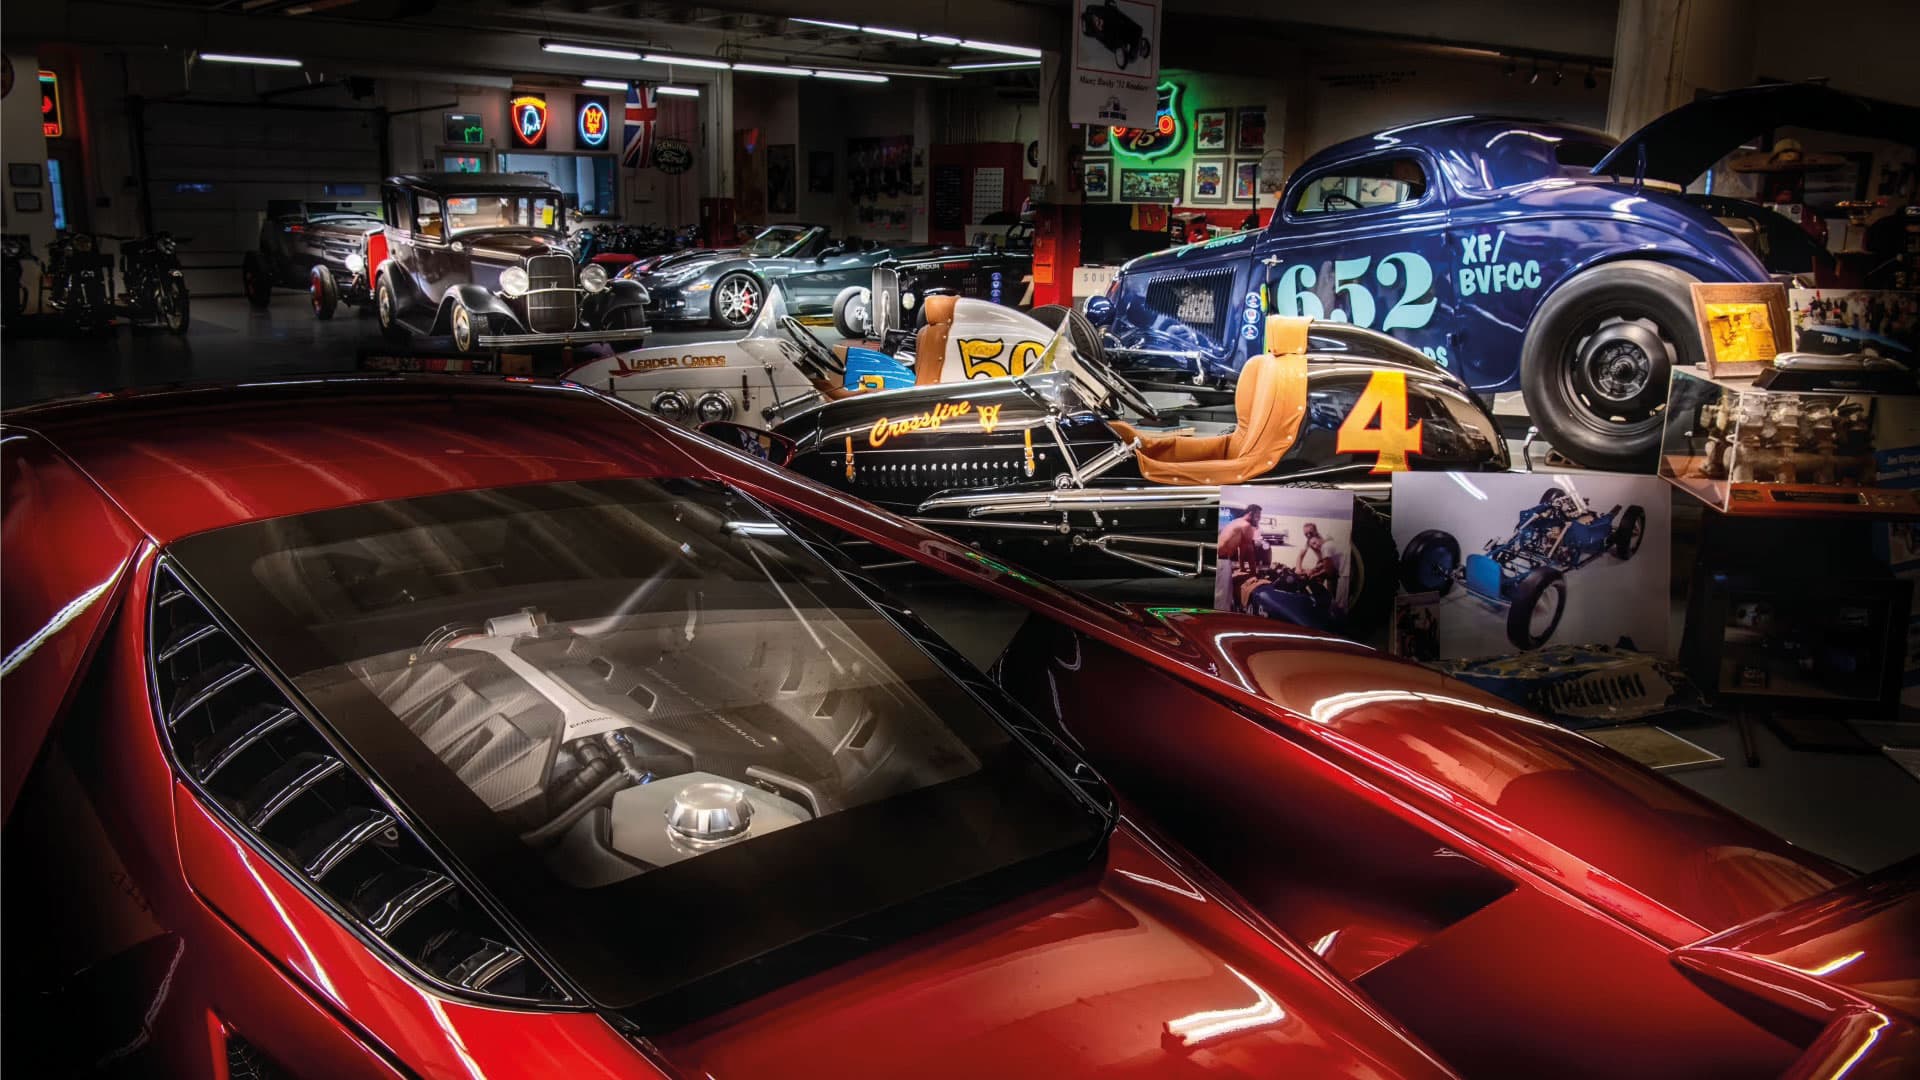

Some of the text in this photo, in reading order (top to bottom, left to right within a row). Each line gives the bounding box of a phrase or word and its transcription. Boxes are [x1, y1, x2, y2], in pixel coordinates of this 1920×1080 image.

[1461, 231, 1506, 265] XF/
[1277, 252, 1437, 332] 652
[1459, 260, 1542, 296] BVFCC
[869, 400, 972, 448] Crossfire
[1336, 370, 1423, 475] 4
